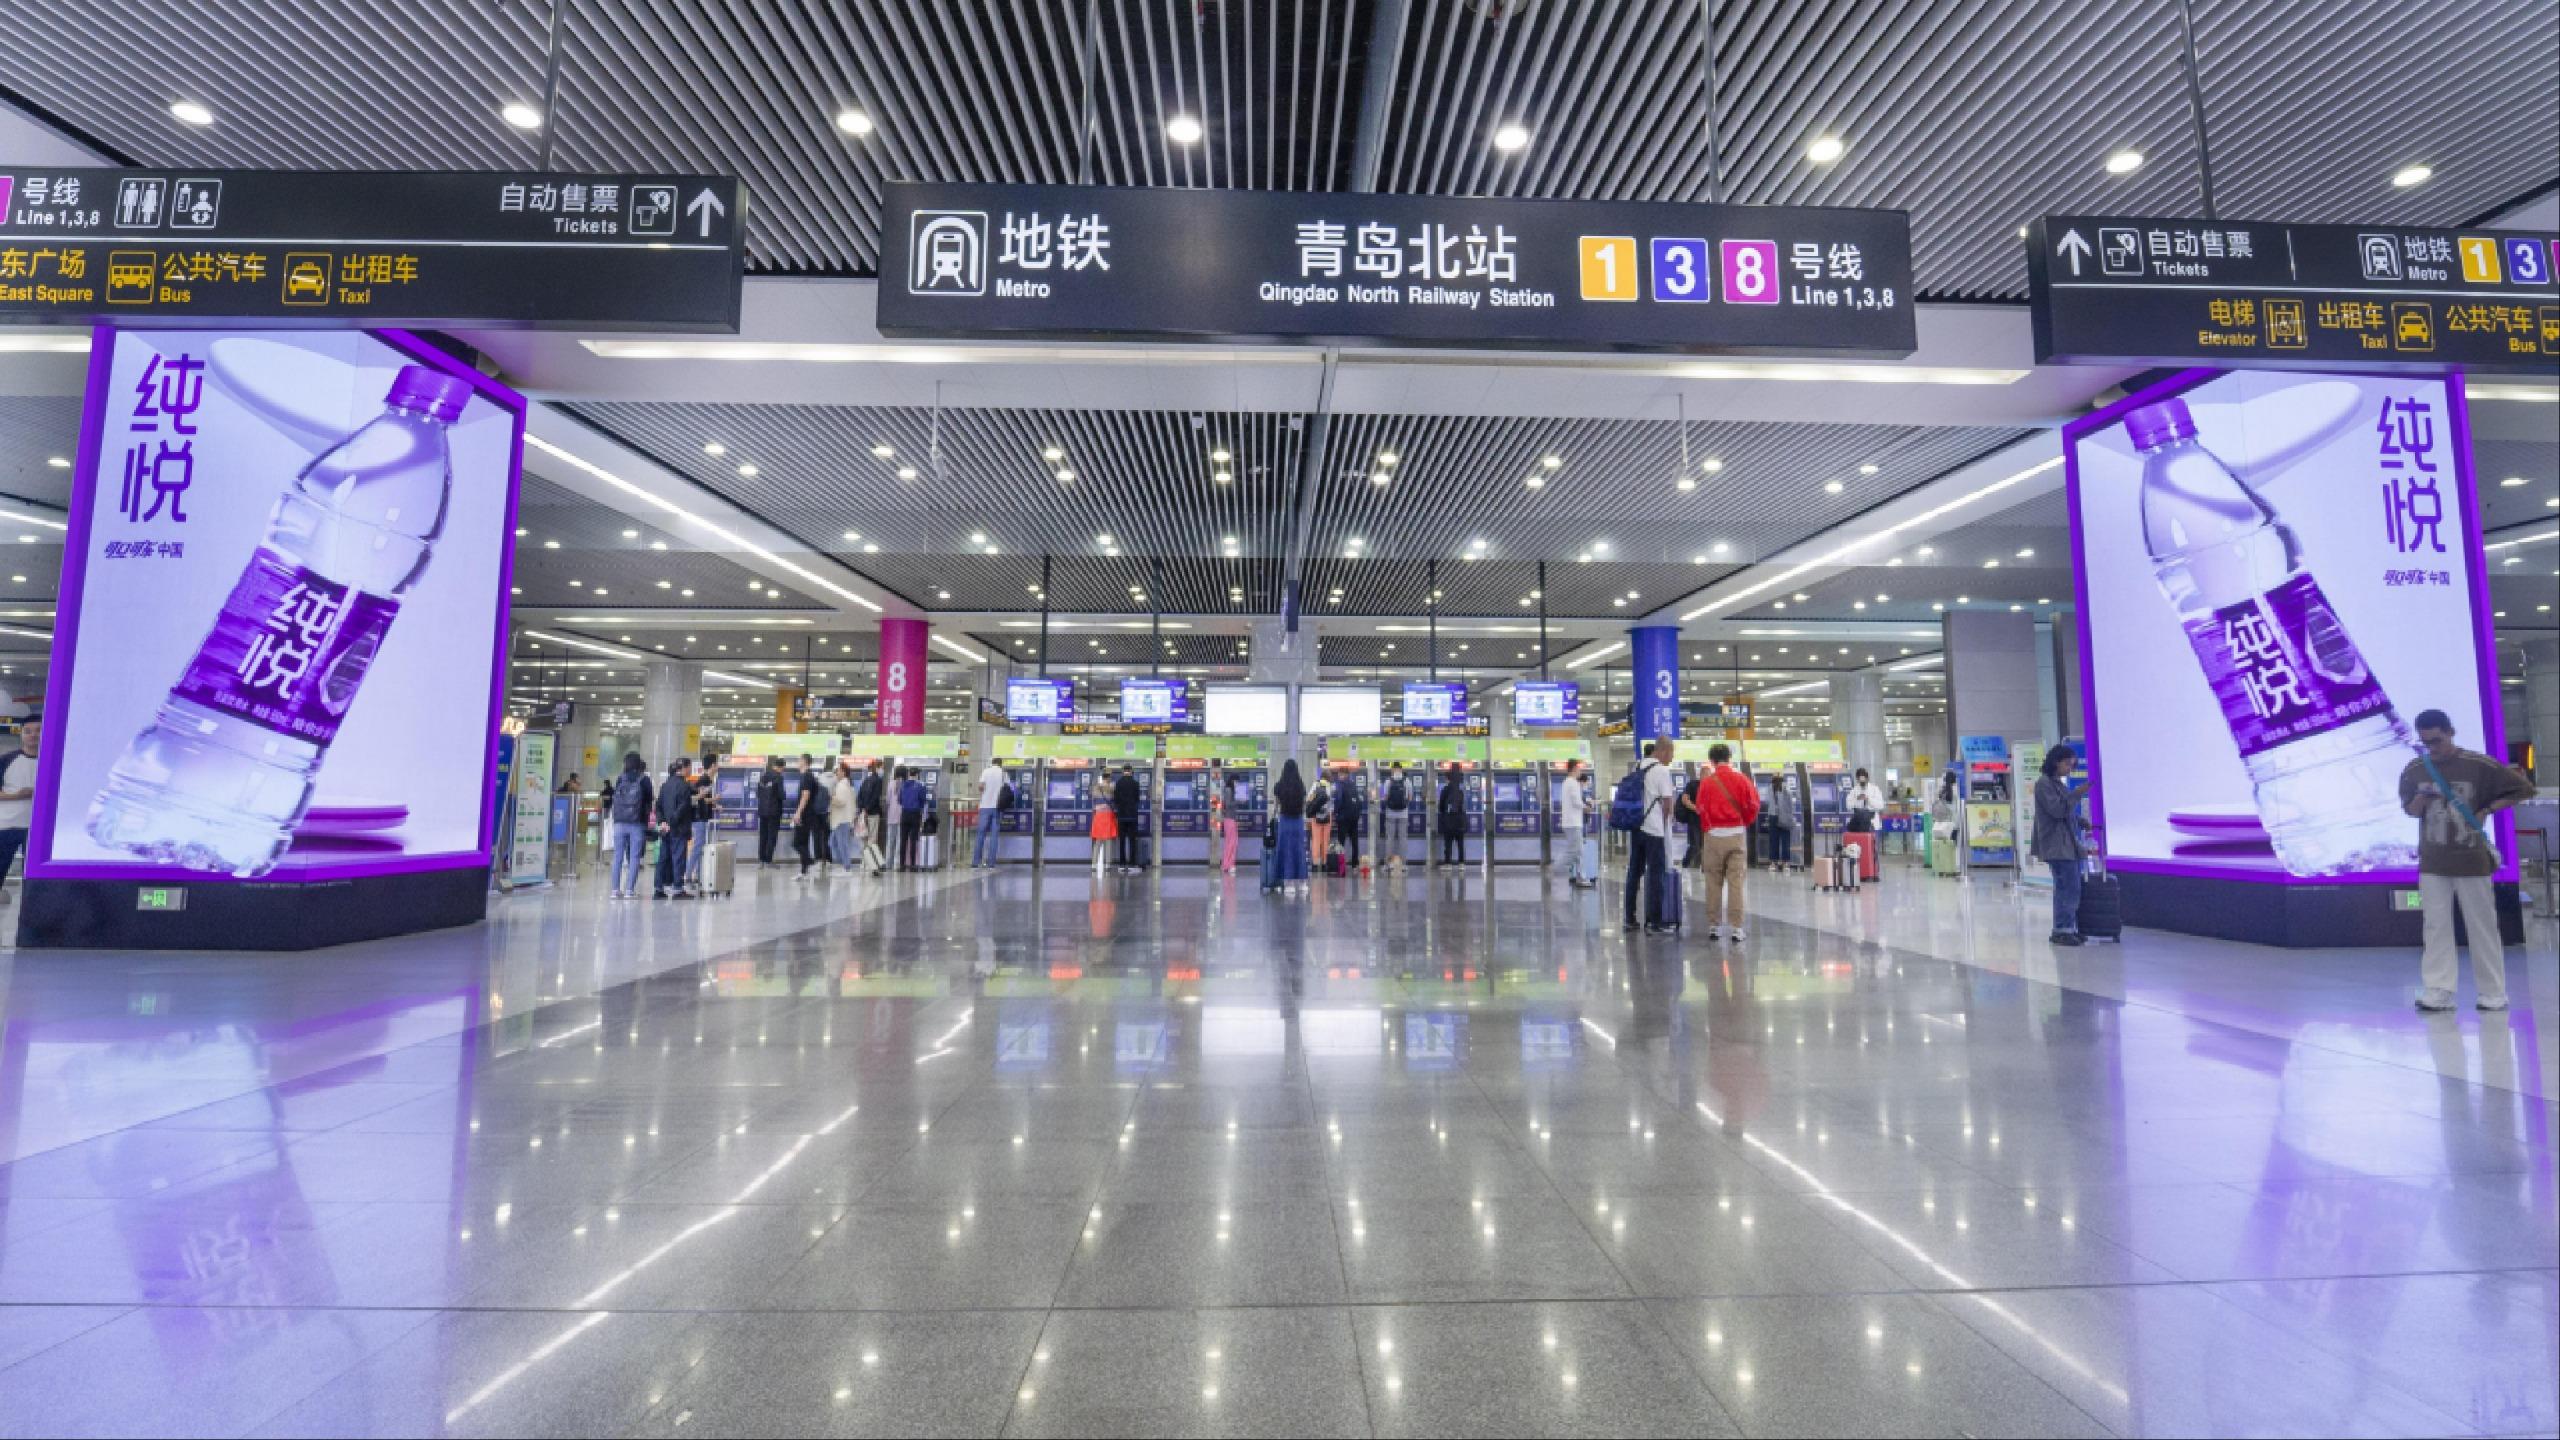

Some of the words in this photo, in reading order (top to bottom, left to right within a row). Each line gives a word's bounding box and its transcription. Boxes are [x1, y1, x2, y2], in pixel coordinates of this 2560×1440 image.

[22, 177, 81, 206] 号线
[501, 183, 620, 213] 自动售票
[16, 210, 55, 224] Line
[59, 210, 100, 228] 1,3,8
[554, 218, 618, 234] Tickets
[999, 211, 1111, 271] 地铁
[1295, 219, 1517, 283] 青岛北站
[2148, 228, 2254, 259] 自动售票
[0, 247, 86, 279] 东广场
[163, 252, 267, 283] 公共汽车
[341, 253, 419, 285] 出租车
[1594, 243, 1617, 292] 1
[1664, 245, 1697, 295] 3
[1735, 247, 1766, 297] 8
[1790, 243, 1863, 281] 号线
[2152, 261, 2210, 278] Tickets
[2404, 235, 2454, 263] 地铁
[2469, 242, 2488, 277] 1
[2515, 243, 2538, 279] 3
[2408, 265, 2448, 281] Metro
[0, 284, 33, 301] East
[36, 284, 95, 304] Square
[159, 286, 191, 303] Bus
[338, 287, 372, 304] Taxi
[996, 278, 1051, 298] Metro
[1259, 282, 1339, 305] Qingdao
[1347, 284, 1399, 304] North
[1408, 286, 1481, 310] Railway
[1489, 287, 1555, 308] Station
[1791, 285, 1838, 306] Line
[1845, 287, 1895, 311] 1,3,8
[2209, 298, 2256, 327] 电梯
[2318, 301, 2387, 330] 出租车
[2446, 304, 2534, 334] 公共汽车
[2198, 329, 2257, 347] Elevator
[2359, 334, 2388, 350] Taxi
[2508, 337, 2538, 353] Bus
[120, 353, 204, 524] 纯悦
[2377, 396, 2447, 553] 纯悦
[237, 581, 340, 700] 纯悦
[887, 661, 907, 692] 8
[2225, 613, 2310, 718] 纯悦
[1655, 669, 1673, 699] 3
